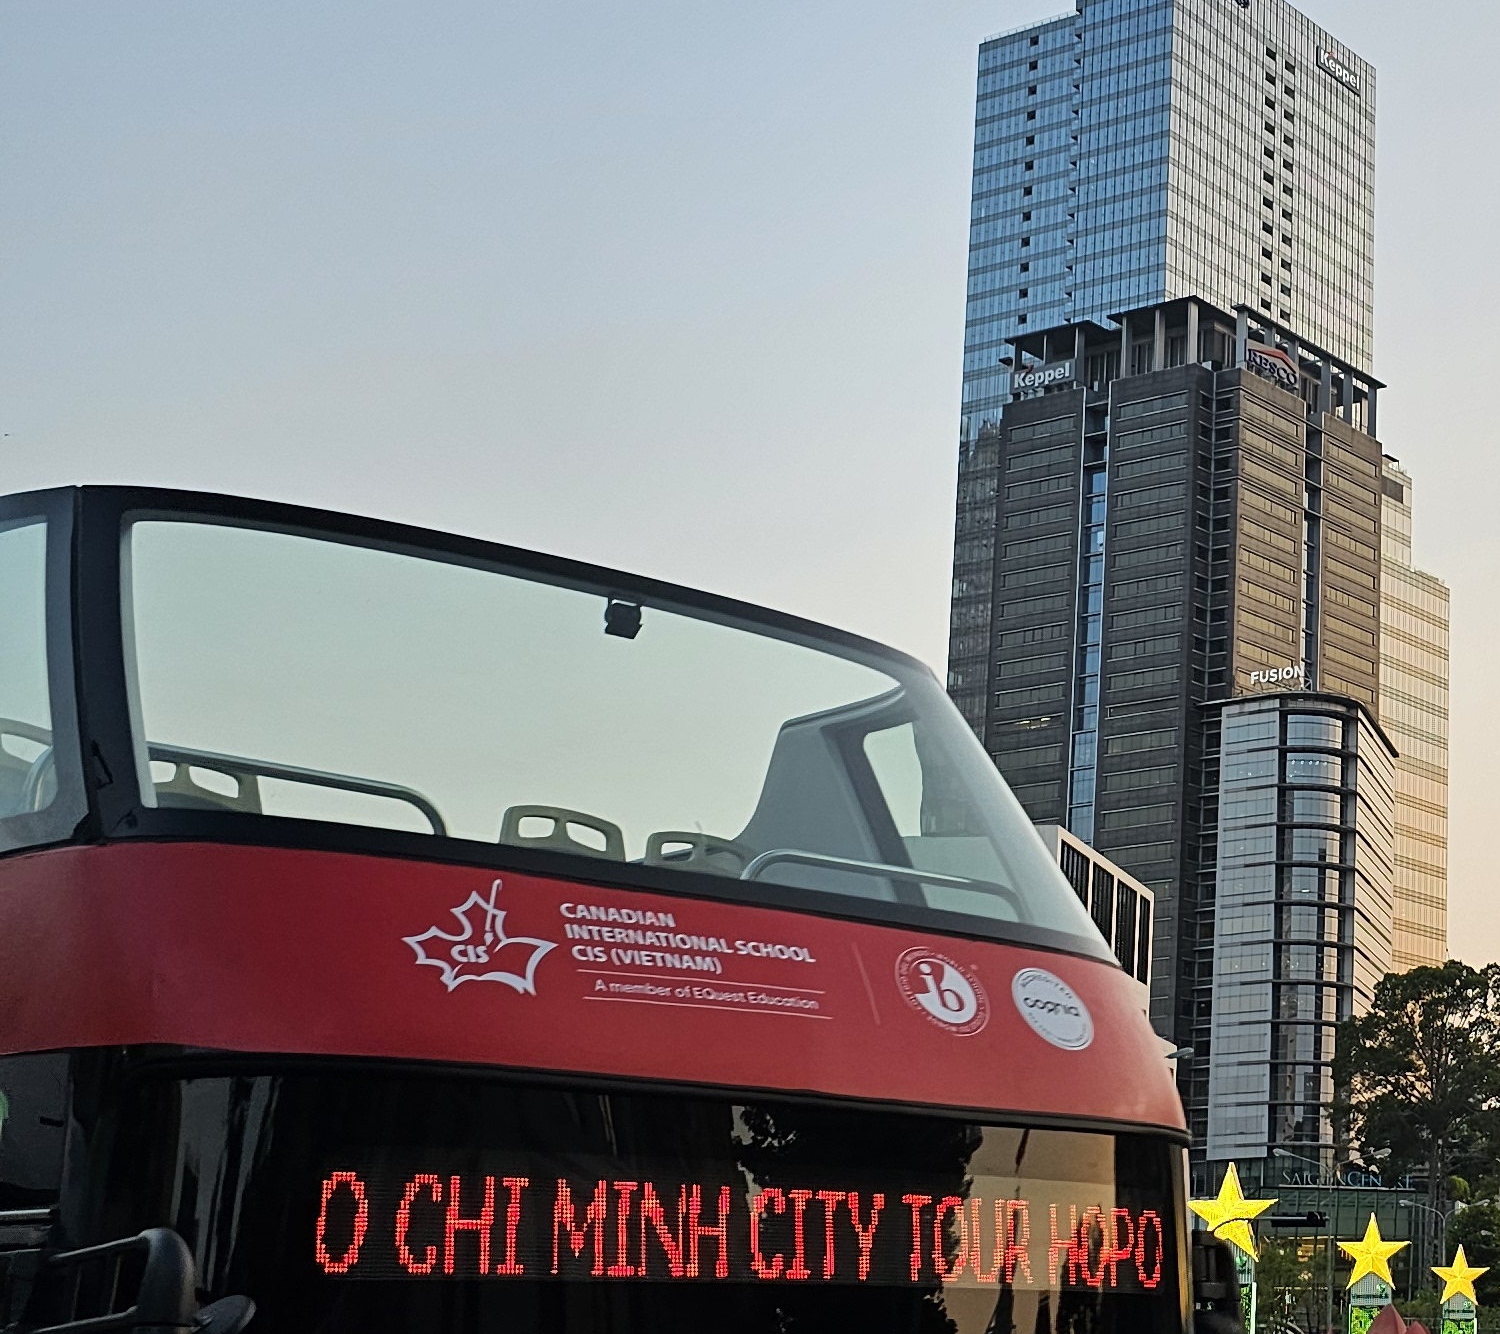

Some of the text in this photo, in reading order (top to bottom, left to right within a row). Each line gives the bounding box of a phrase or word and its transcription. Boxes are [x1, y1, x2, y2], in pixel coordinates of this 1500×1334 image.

[1319, 49, 1360, 90] Keppel
[1014, 362, 1070, 389] Keppel
[1250, 665, 1305, 685] FUSION
[560, 902, 676, 928] CANADIAN
[450, 943, 490, 964] CIS
[564, 923, 816, 964] INTERNATIONAL SCHOOL
[571, 945, 723, 975] CIS (VIETNAM)
[595, 979, 820, 1010] A member of EQuest Education
[315, 1171, 1164, 1288] O CHI MINH CITY TOUR HOPO
